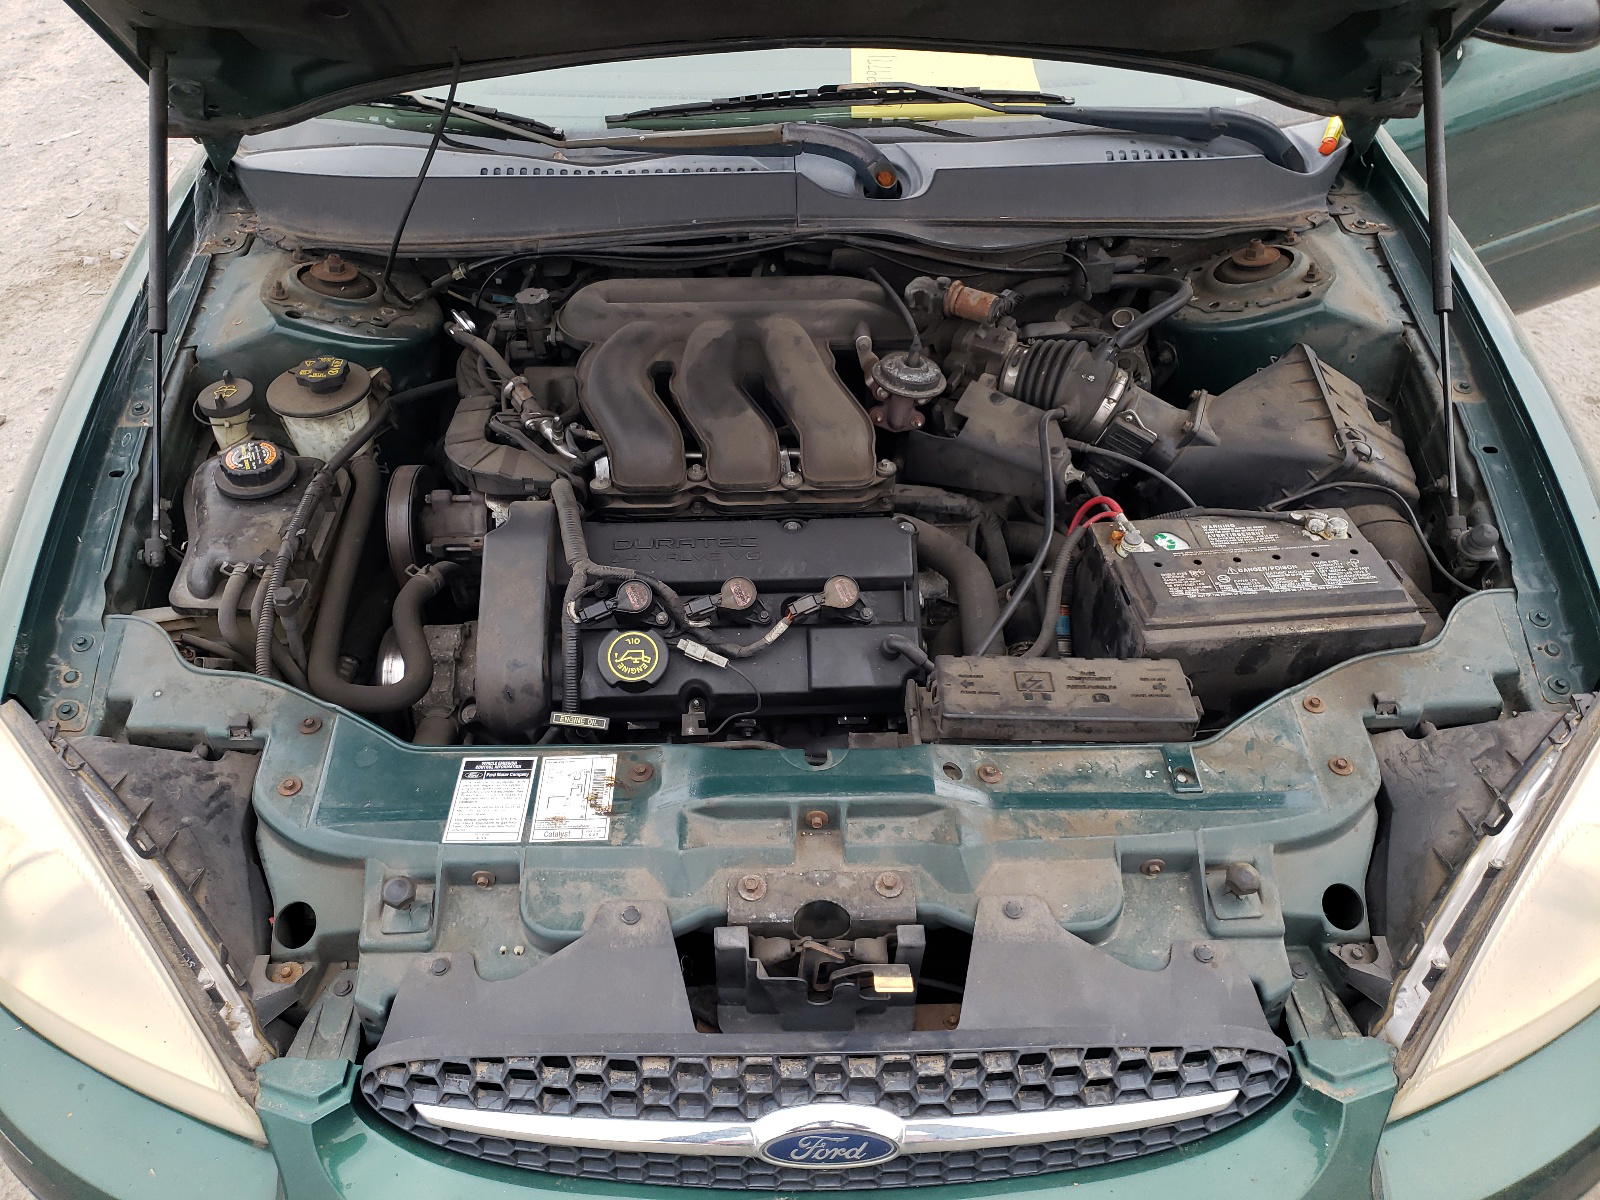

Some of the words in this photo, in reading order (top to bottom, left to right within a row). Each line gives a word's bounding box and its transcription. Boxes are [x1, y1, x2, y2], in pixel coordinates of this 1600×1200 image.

[613, 536, 759, 551] DURATEC
[624, 637, 641, 645] OIL
[617, 662, 649, 675] ENGINE
[543, 830, 571, 839] Catalyst
[790, 1135, 869, 1160] Ford
